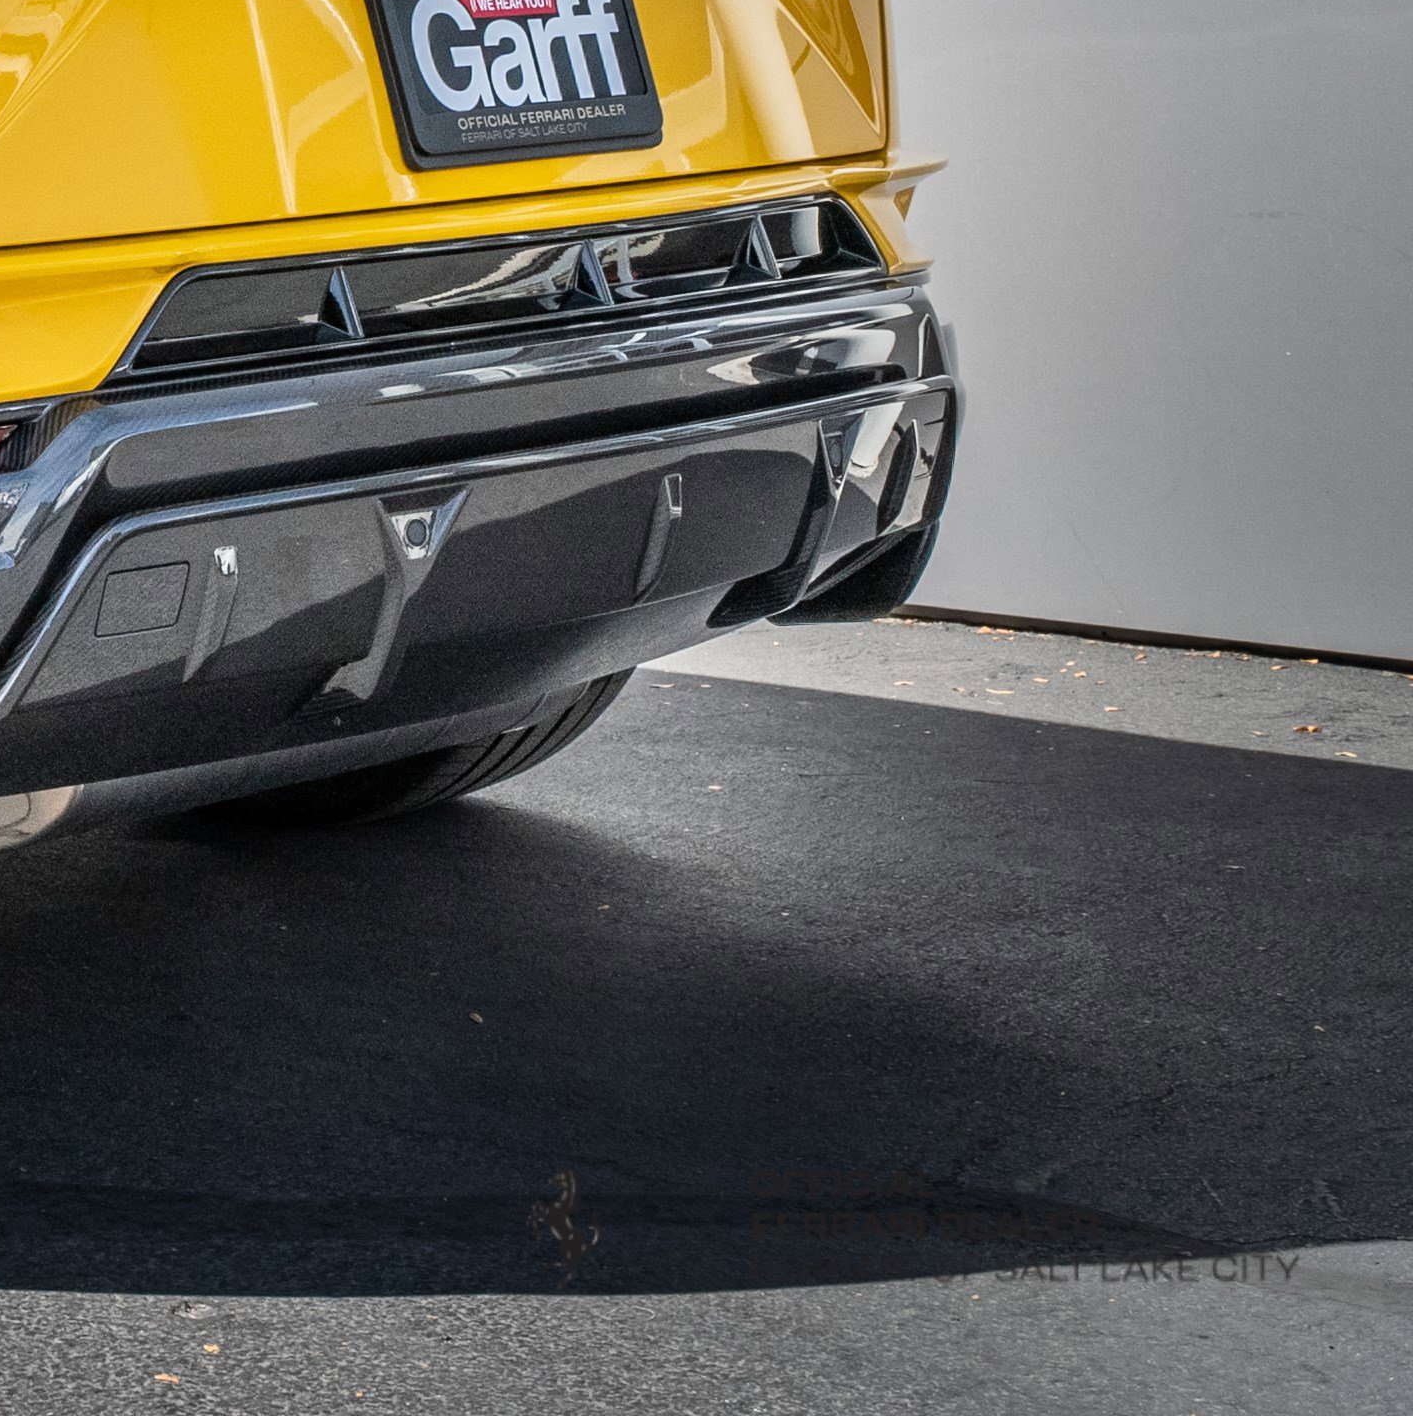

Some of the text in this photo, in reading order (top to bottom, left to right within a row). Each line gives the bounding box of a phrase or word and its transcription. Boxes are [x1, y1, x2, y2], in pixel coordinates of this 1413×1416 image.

[457, 103, 627, 130] OFFICIAL FERRARI DEALER
[461, 121, 588, 144] FERRARI OF SALT LAKE CITY
